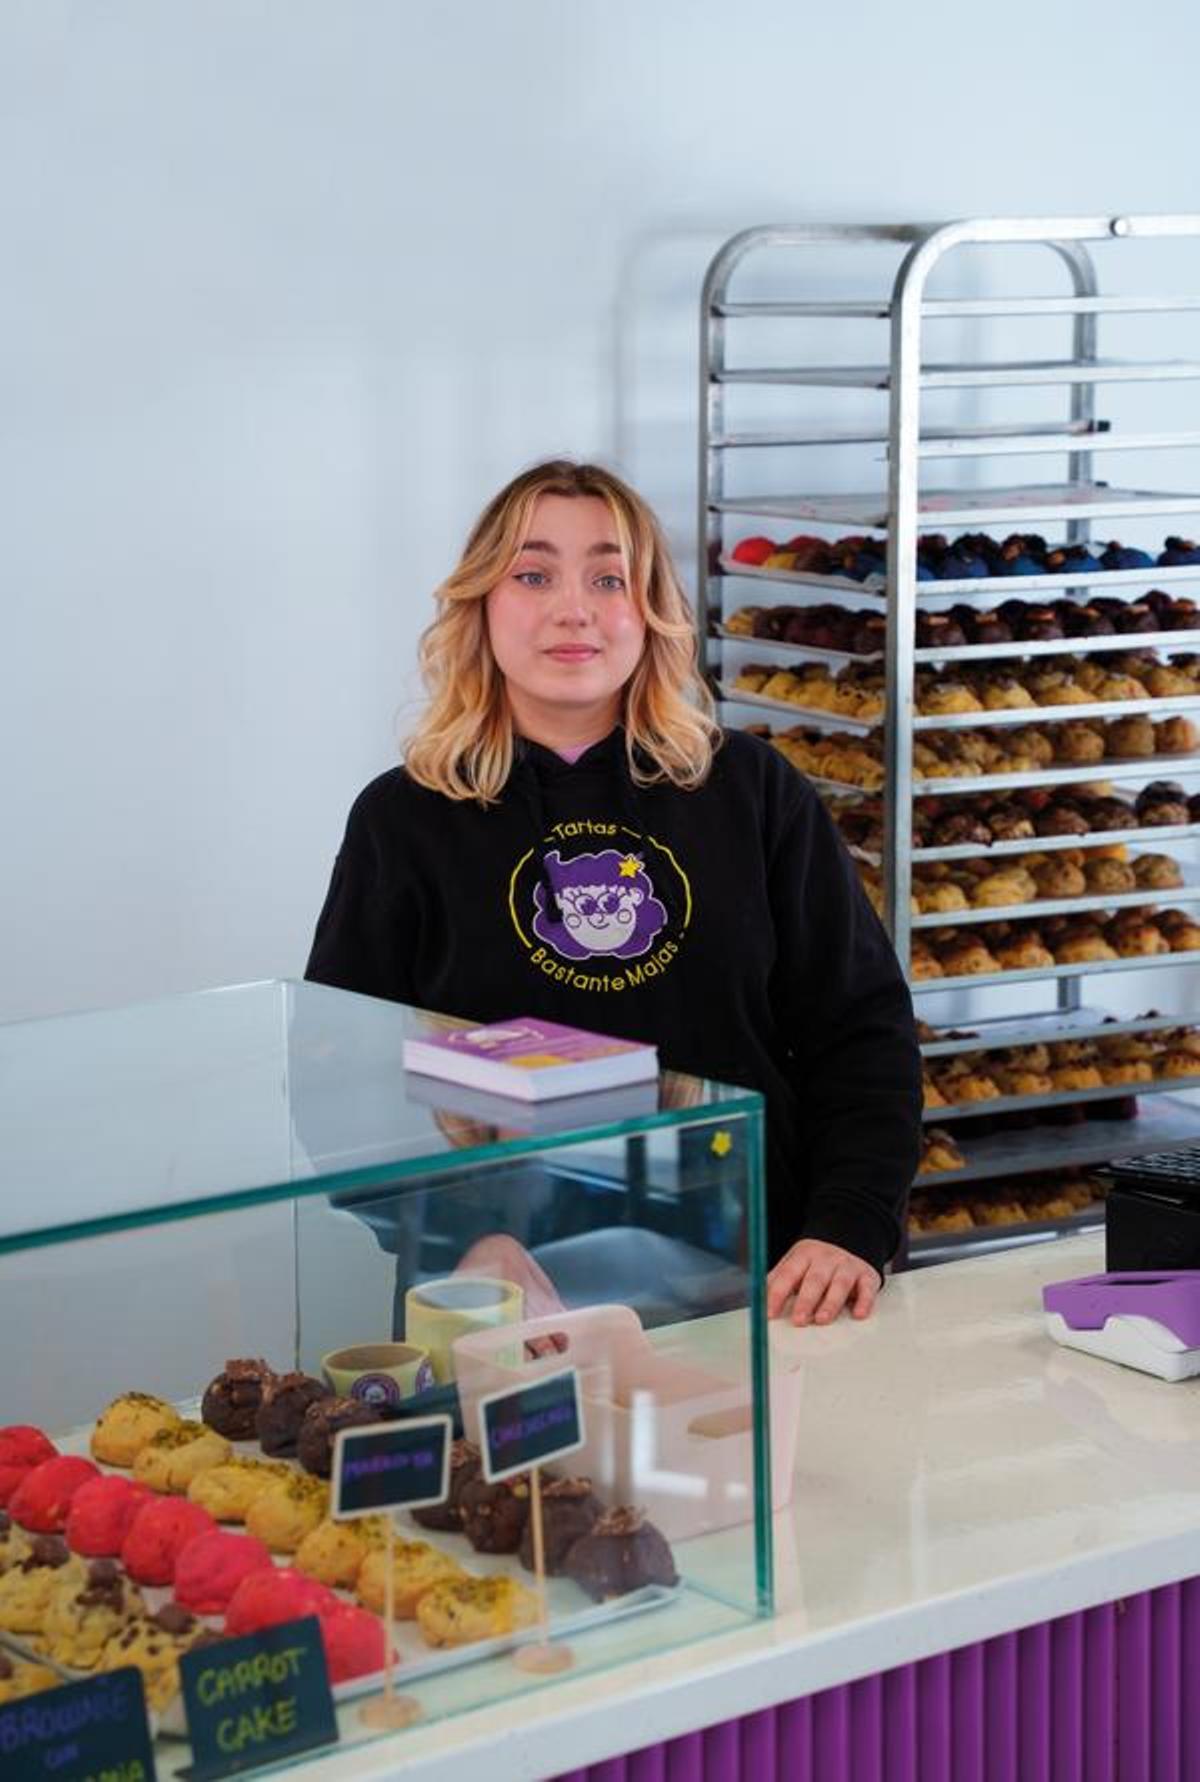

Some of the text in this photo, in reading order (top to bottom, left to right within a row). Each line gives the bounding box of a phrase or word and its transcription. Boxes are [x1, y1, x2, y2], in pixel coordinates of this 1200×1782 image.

[551, 819, 617, 840] Tartas
[530, 940, 679, 992] Bastante Majas
[197, 1646, 308, 1707] CARROT
[216, 1698, 298, 1751] CAKE
